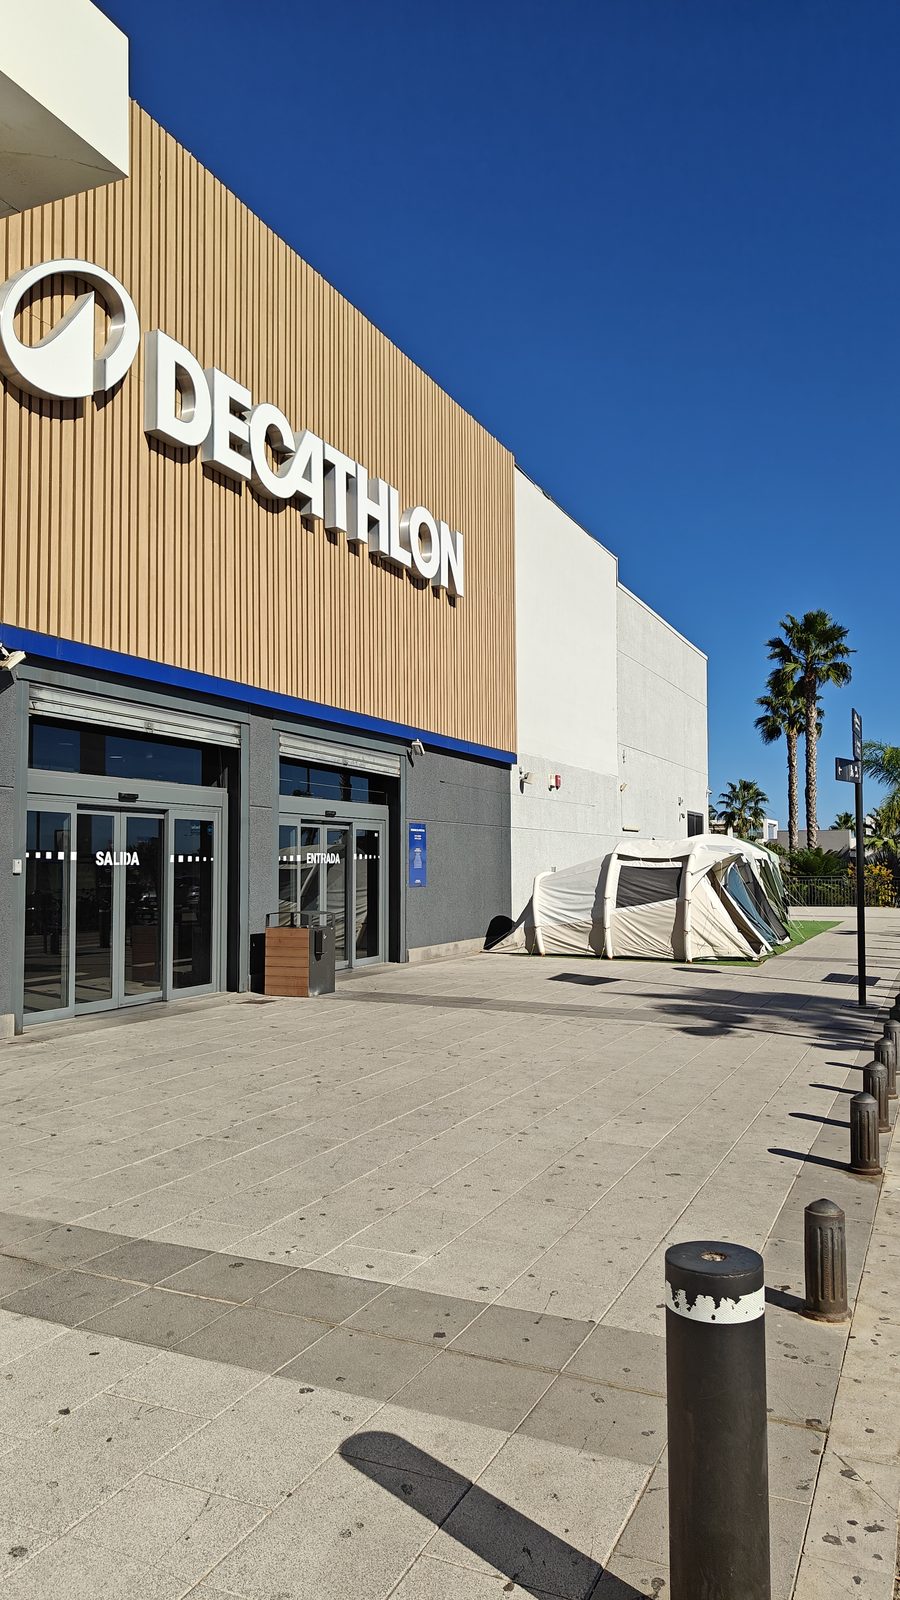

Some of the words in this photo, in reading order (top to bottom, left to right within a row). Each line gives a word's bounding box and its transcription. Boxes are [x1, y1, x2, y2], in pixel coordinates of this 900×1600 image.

[145, 329, 464, 598] DECATHLON
[95, 851, 140, 866] SALIDA
[306, 852, 341, 864] ENTRADA
